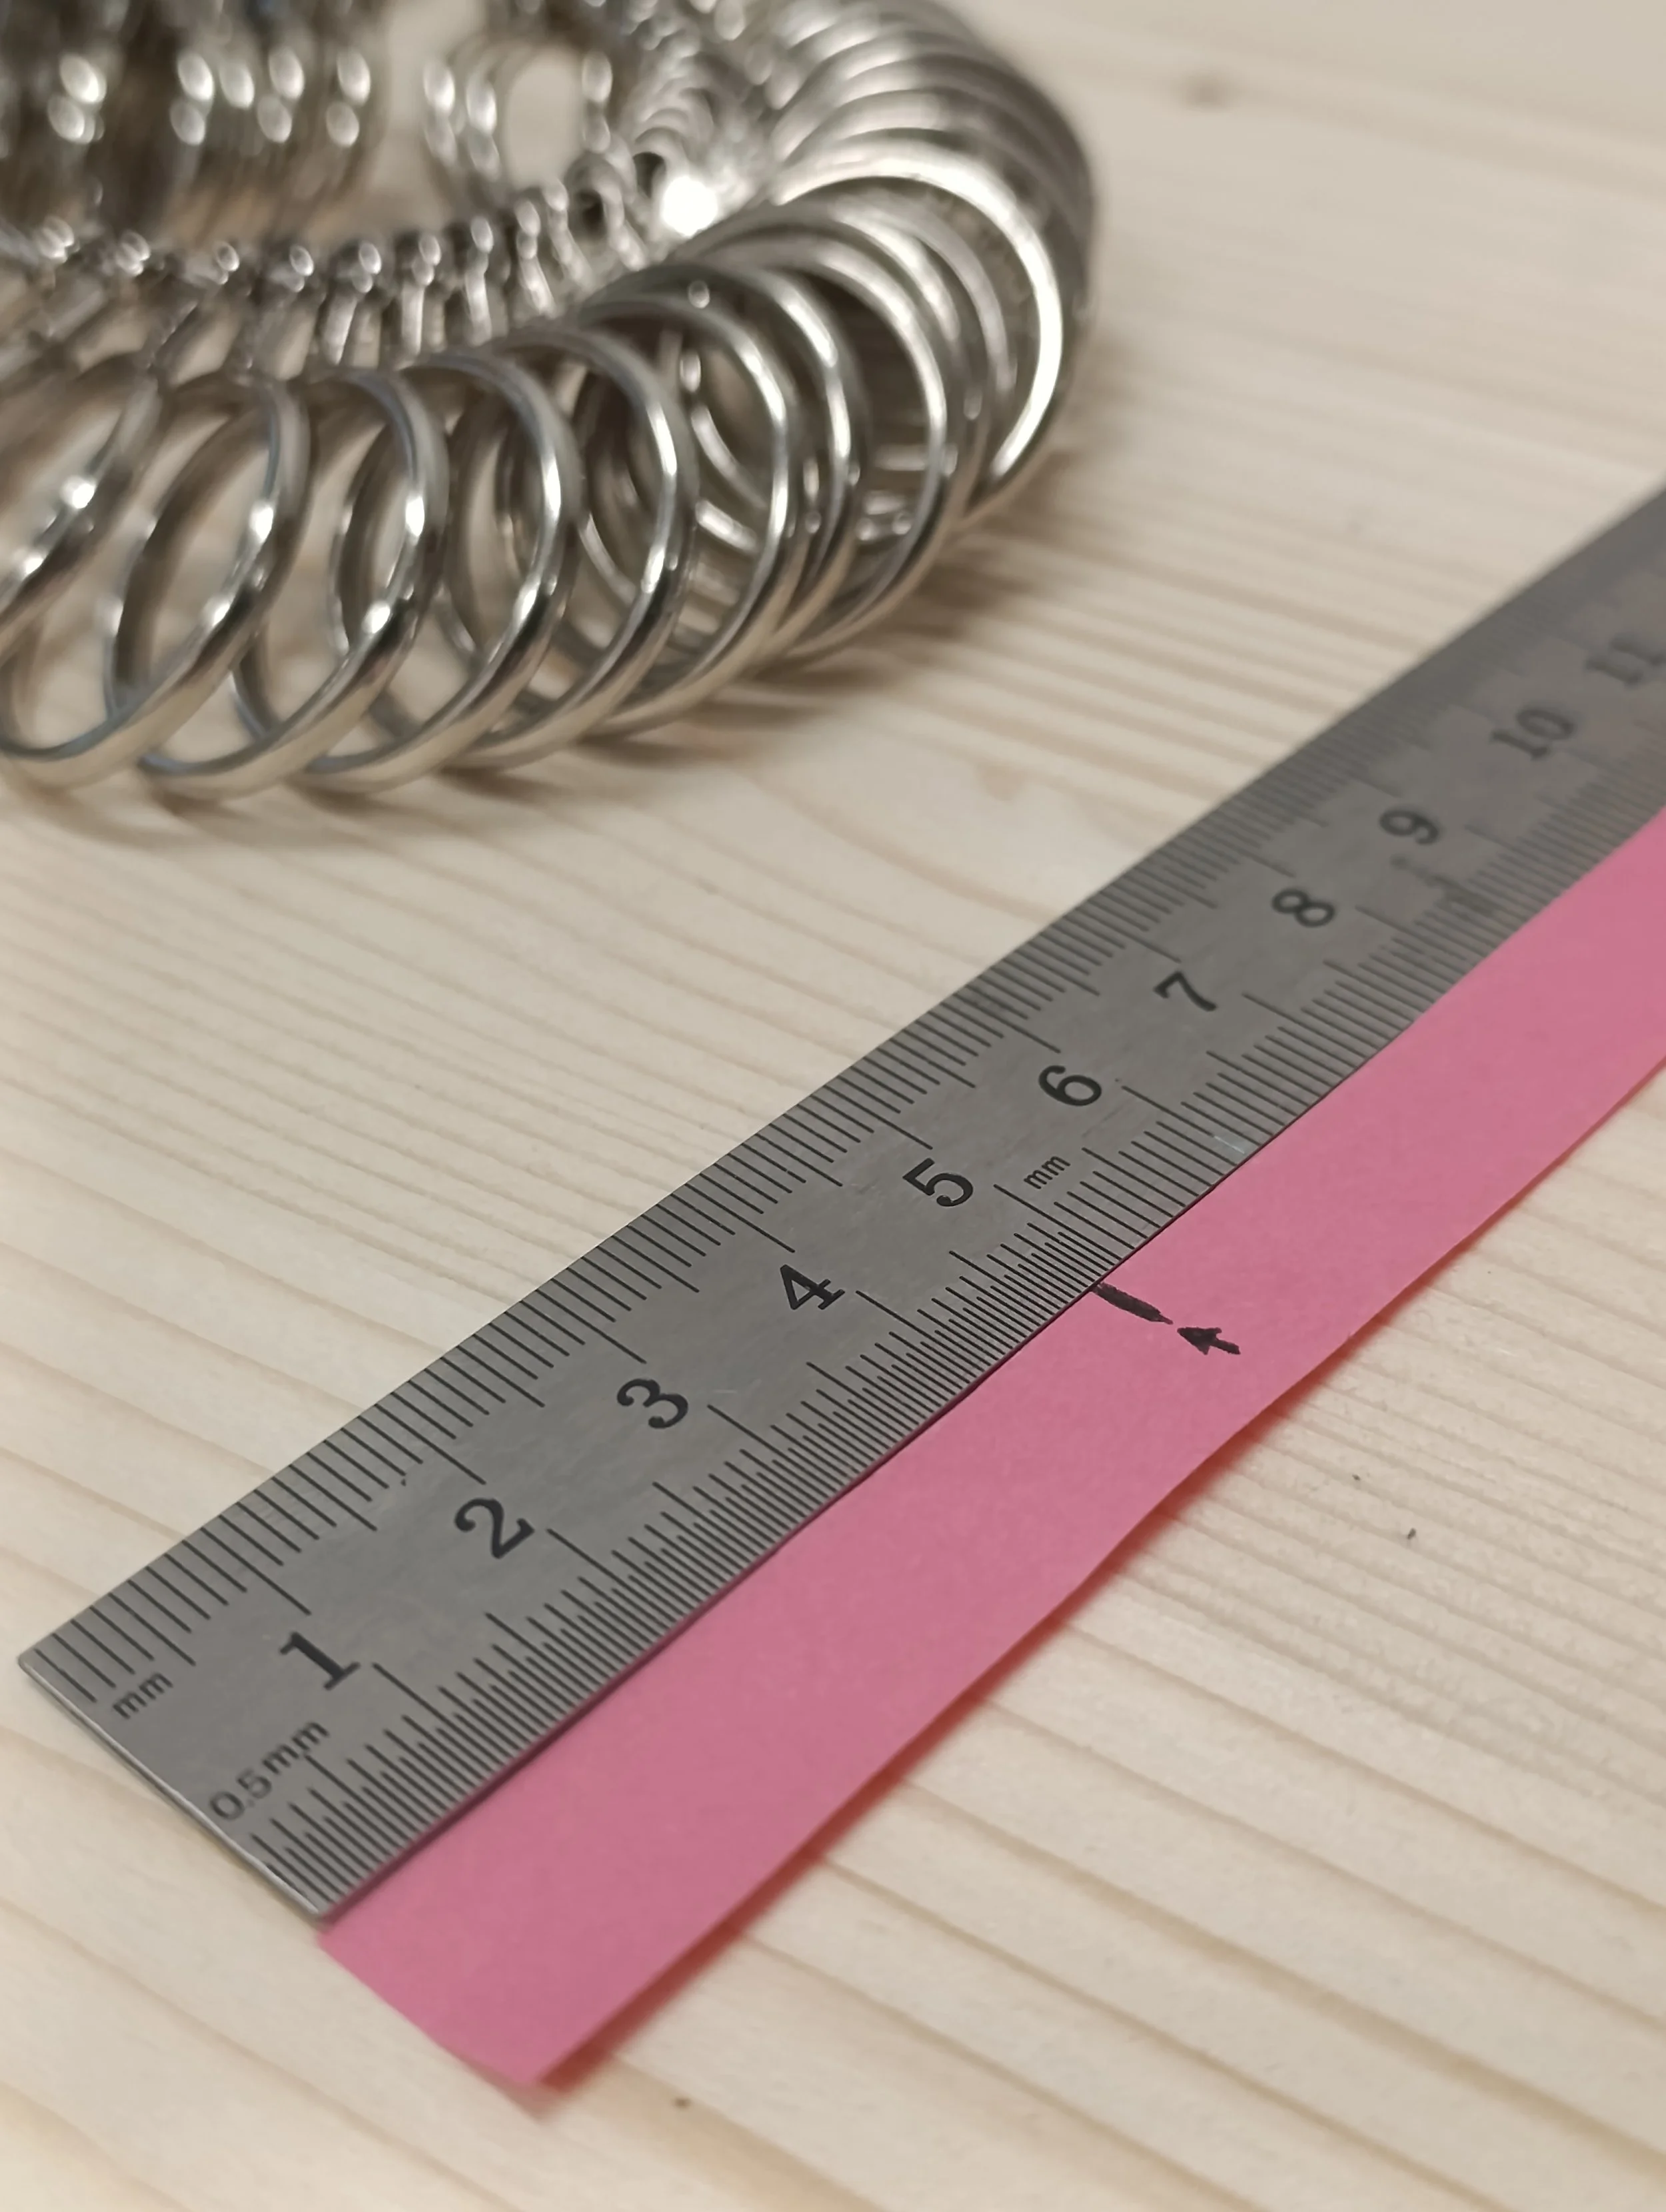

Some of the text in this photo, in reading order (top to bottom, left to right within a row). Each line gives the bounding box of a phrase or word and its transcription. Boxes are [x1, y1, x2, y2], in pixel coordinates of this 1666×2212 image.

[279, 634, 1666, 1690] 1 2 3 4 5 6 7 8 9 10 11
[1024, 1155, 1071, 1191] mm
[111, 1671, 173, 1719] mm
